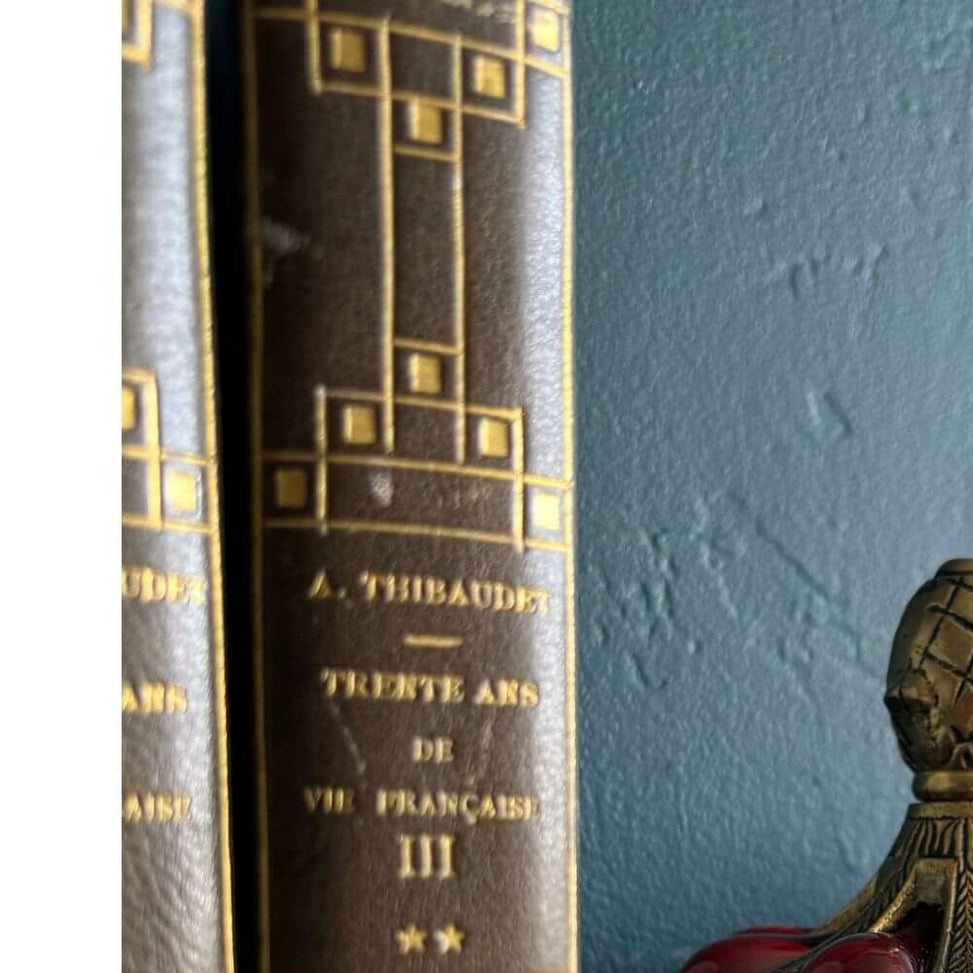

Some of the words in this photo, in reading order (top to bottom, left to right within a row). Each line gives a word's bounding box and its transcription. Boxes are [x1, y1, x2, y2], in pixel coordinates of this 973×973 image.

[308, 568, 347, 598] A.
[359, 570, 551, 615] THIBAUDET
[320, 668, 466, 703] TRENTE
[474, 678, 539, 707] ANS
[412, 736, 455, 763] DE
[304, 785, 356, 813] VIE
[376, 788, 539, 826] FRANÇAISE
[398, 833, 456, 879] III
